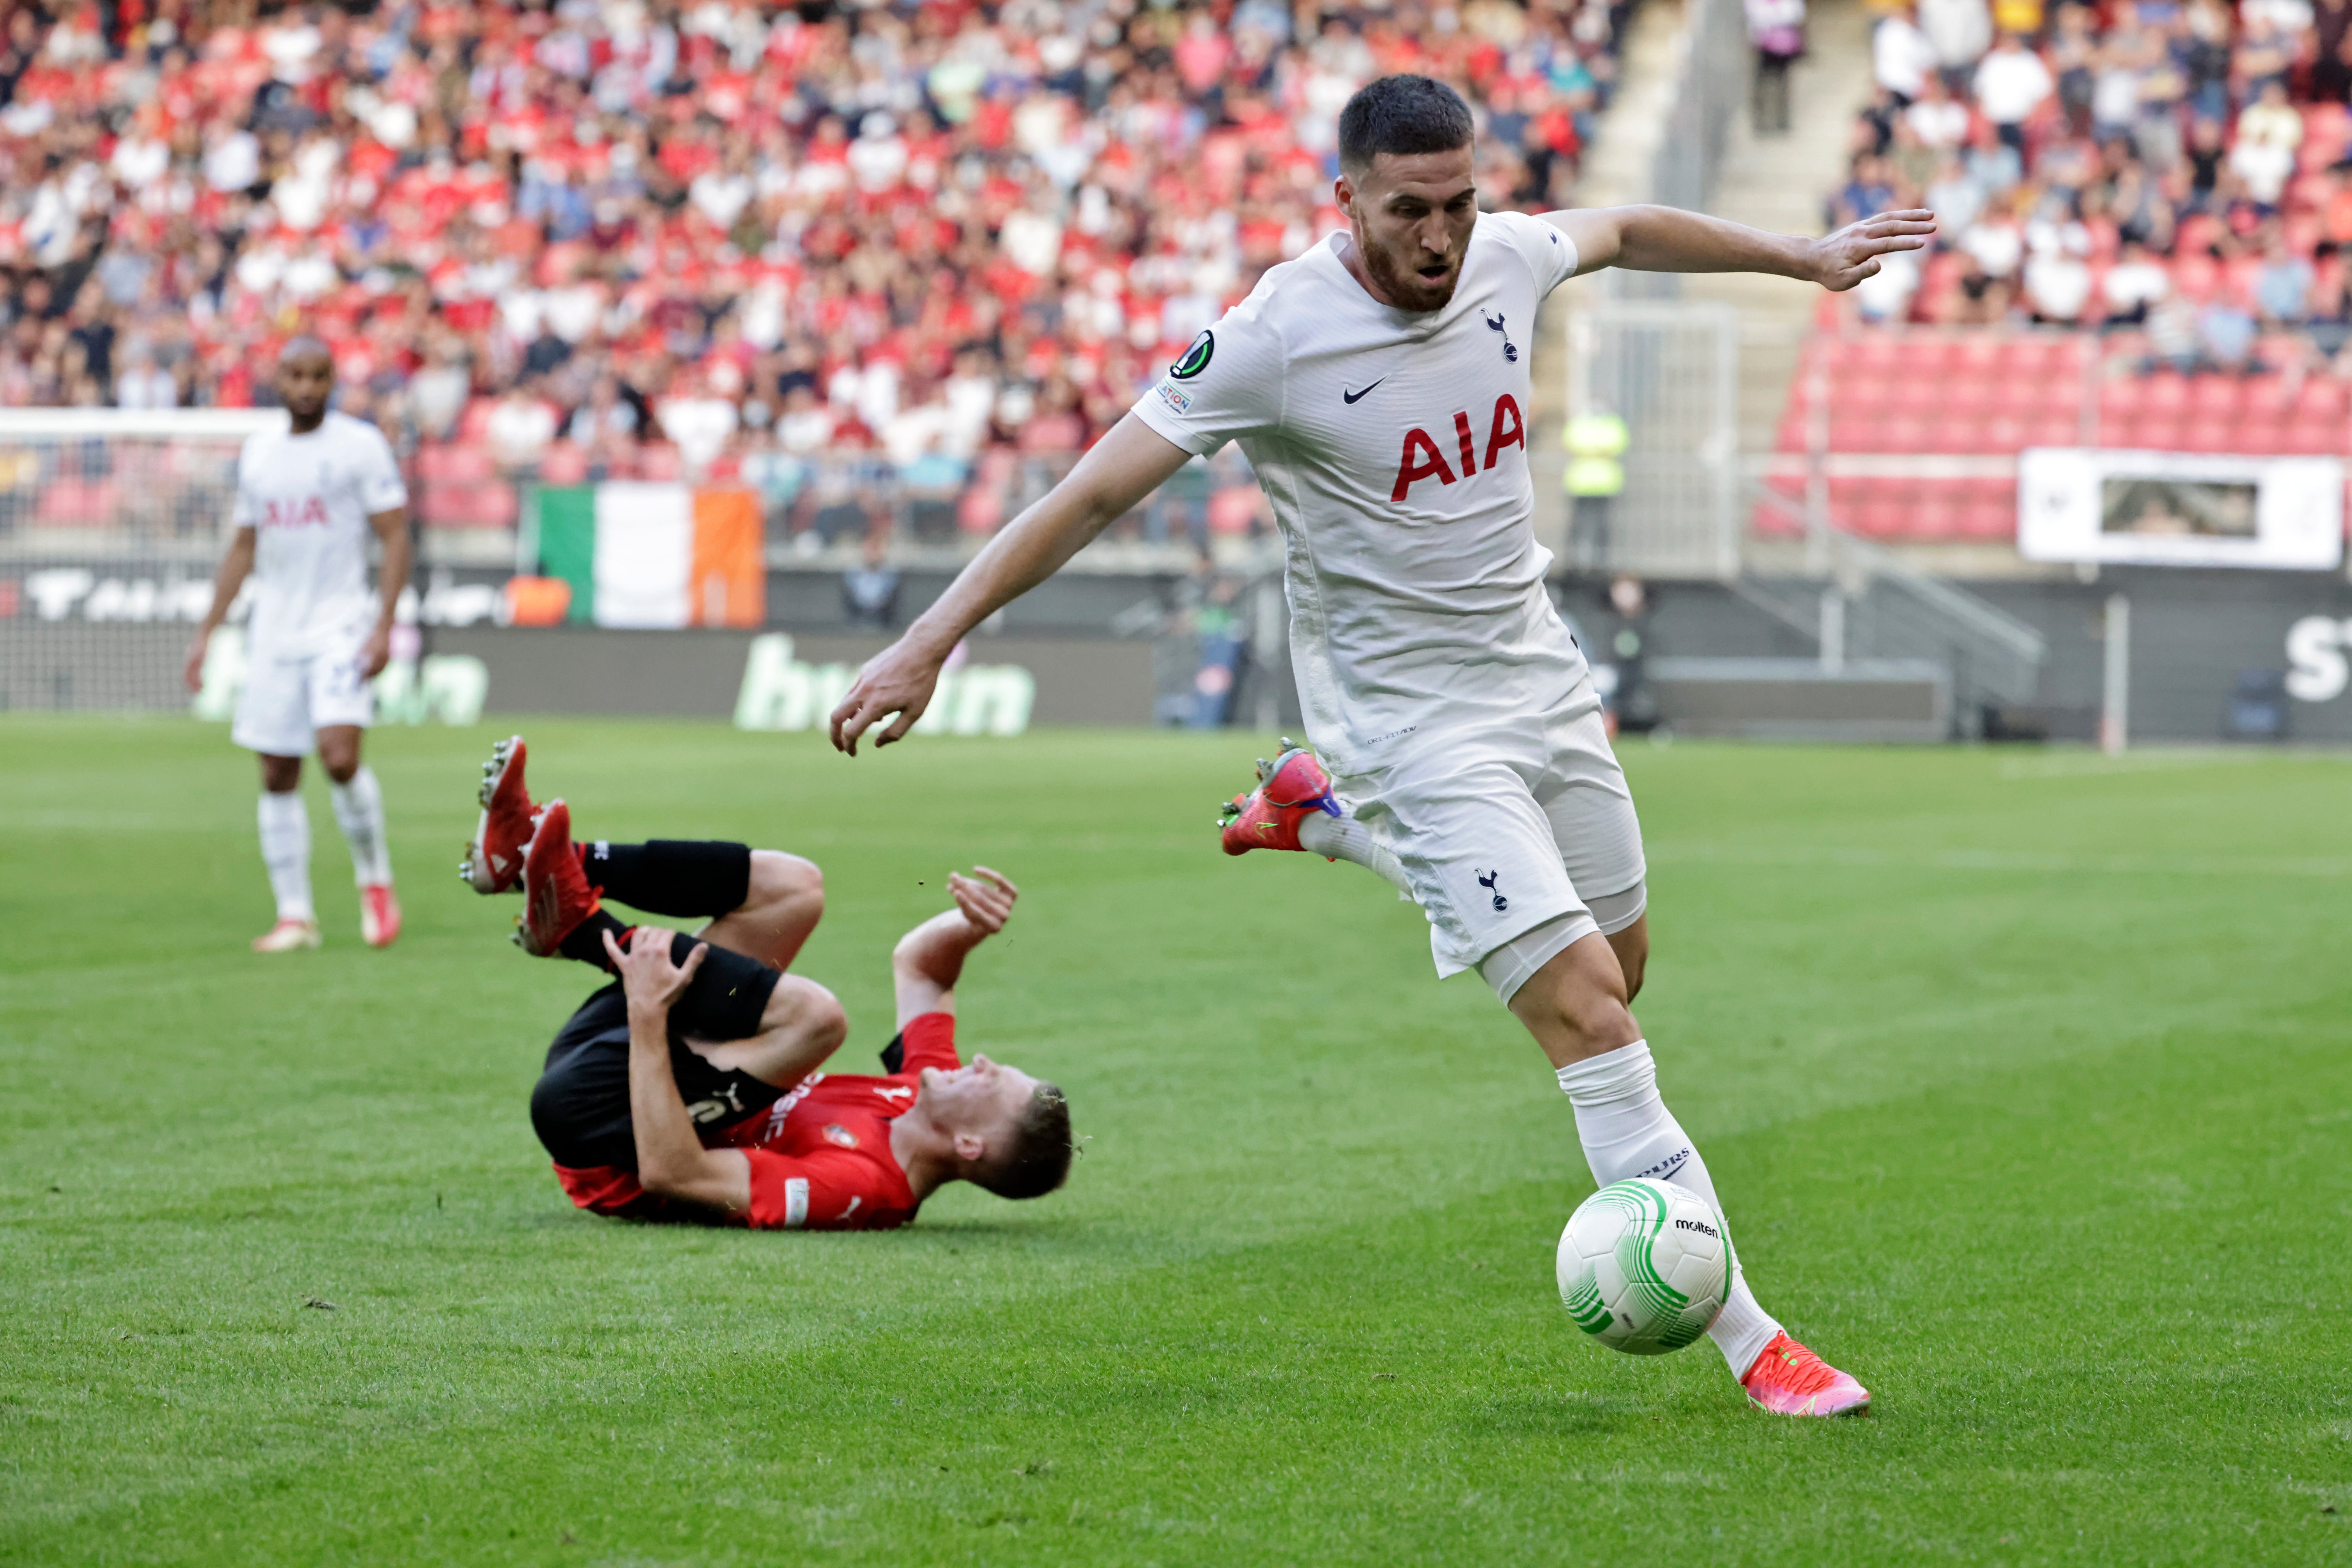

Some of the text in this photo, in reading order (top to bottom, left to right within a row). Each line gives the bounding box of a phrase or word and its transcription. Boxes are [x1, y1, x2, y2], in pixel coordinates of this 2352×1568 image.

[1391, 394, 1524, 502] AIA
[263, 496, 331, 530] AIA
[1635, 1148, 1689, 1178] PURS
[1676, 1219, 1718, 1239] molten
